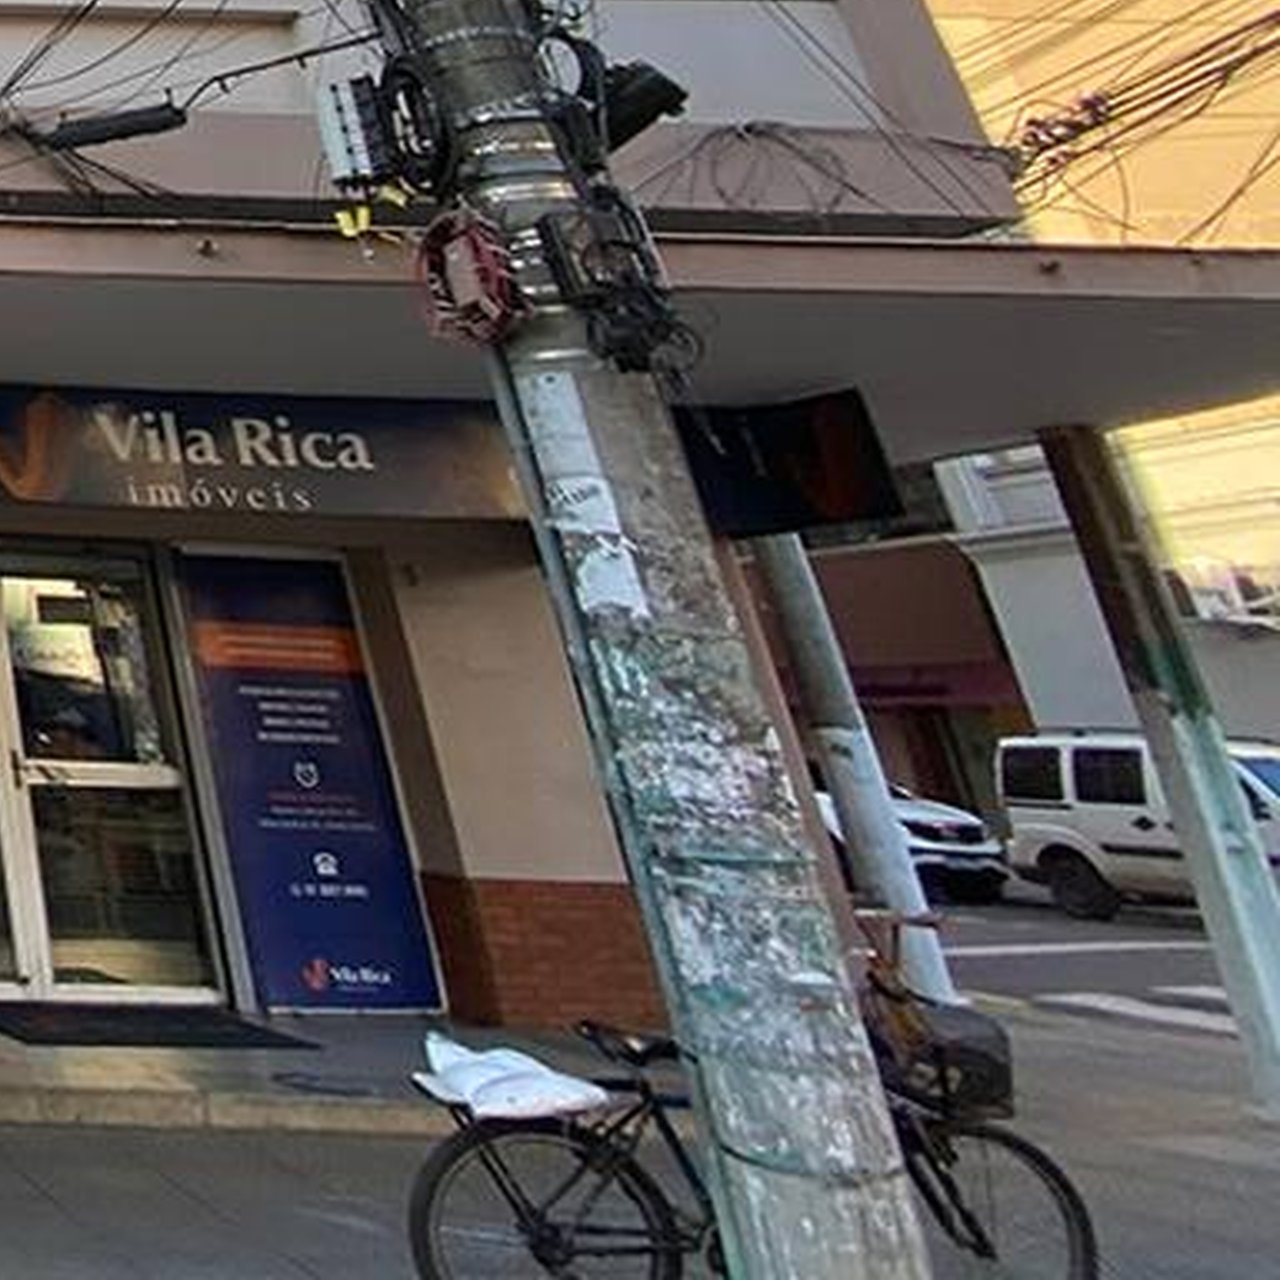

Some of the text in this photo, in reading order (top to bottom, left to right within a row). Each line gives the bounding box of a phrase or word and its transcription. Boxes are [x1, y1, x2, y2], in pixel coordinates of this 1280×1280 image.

[91, 409, 376, 471] Vila Rica
[126, 476, 313, 512] imóveis
